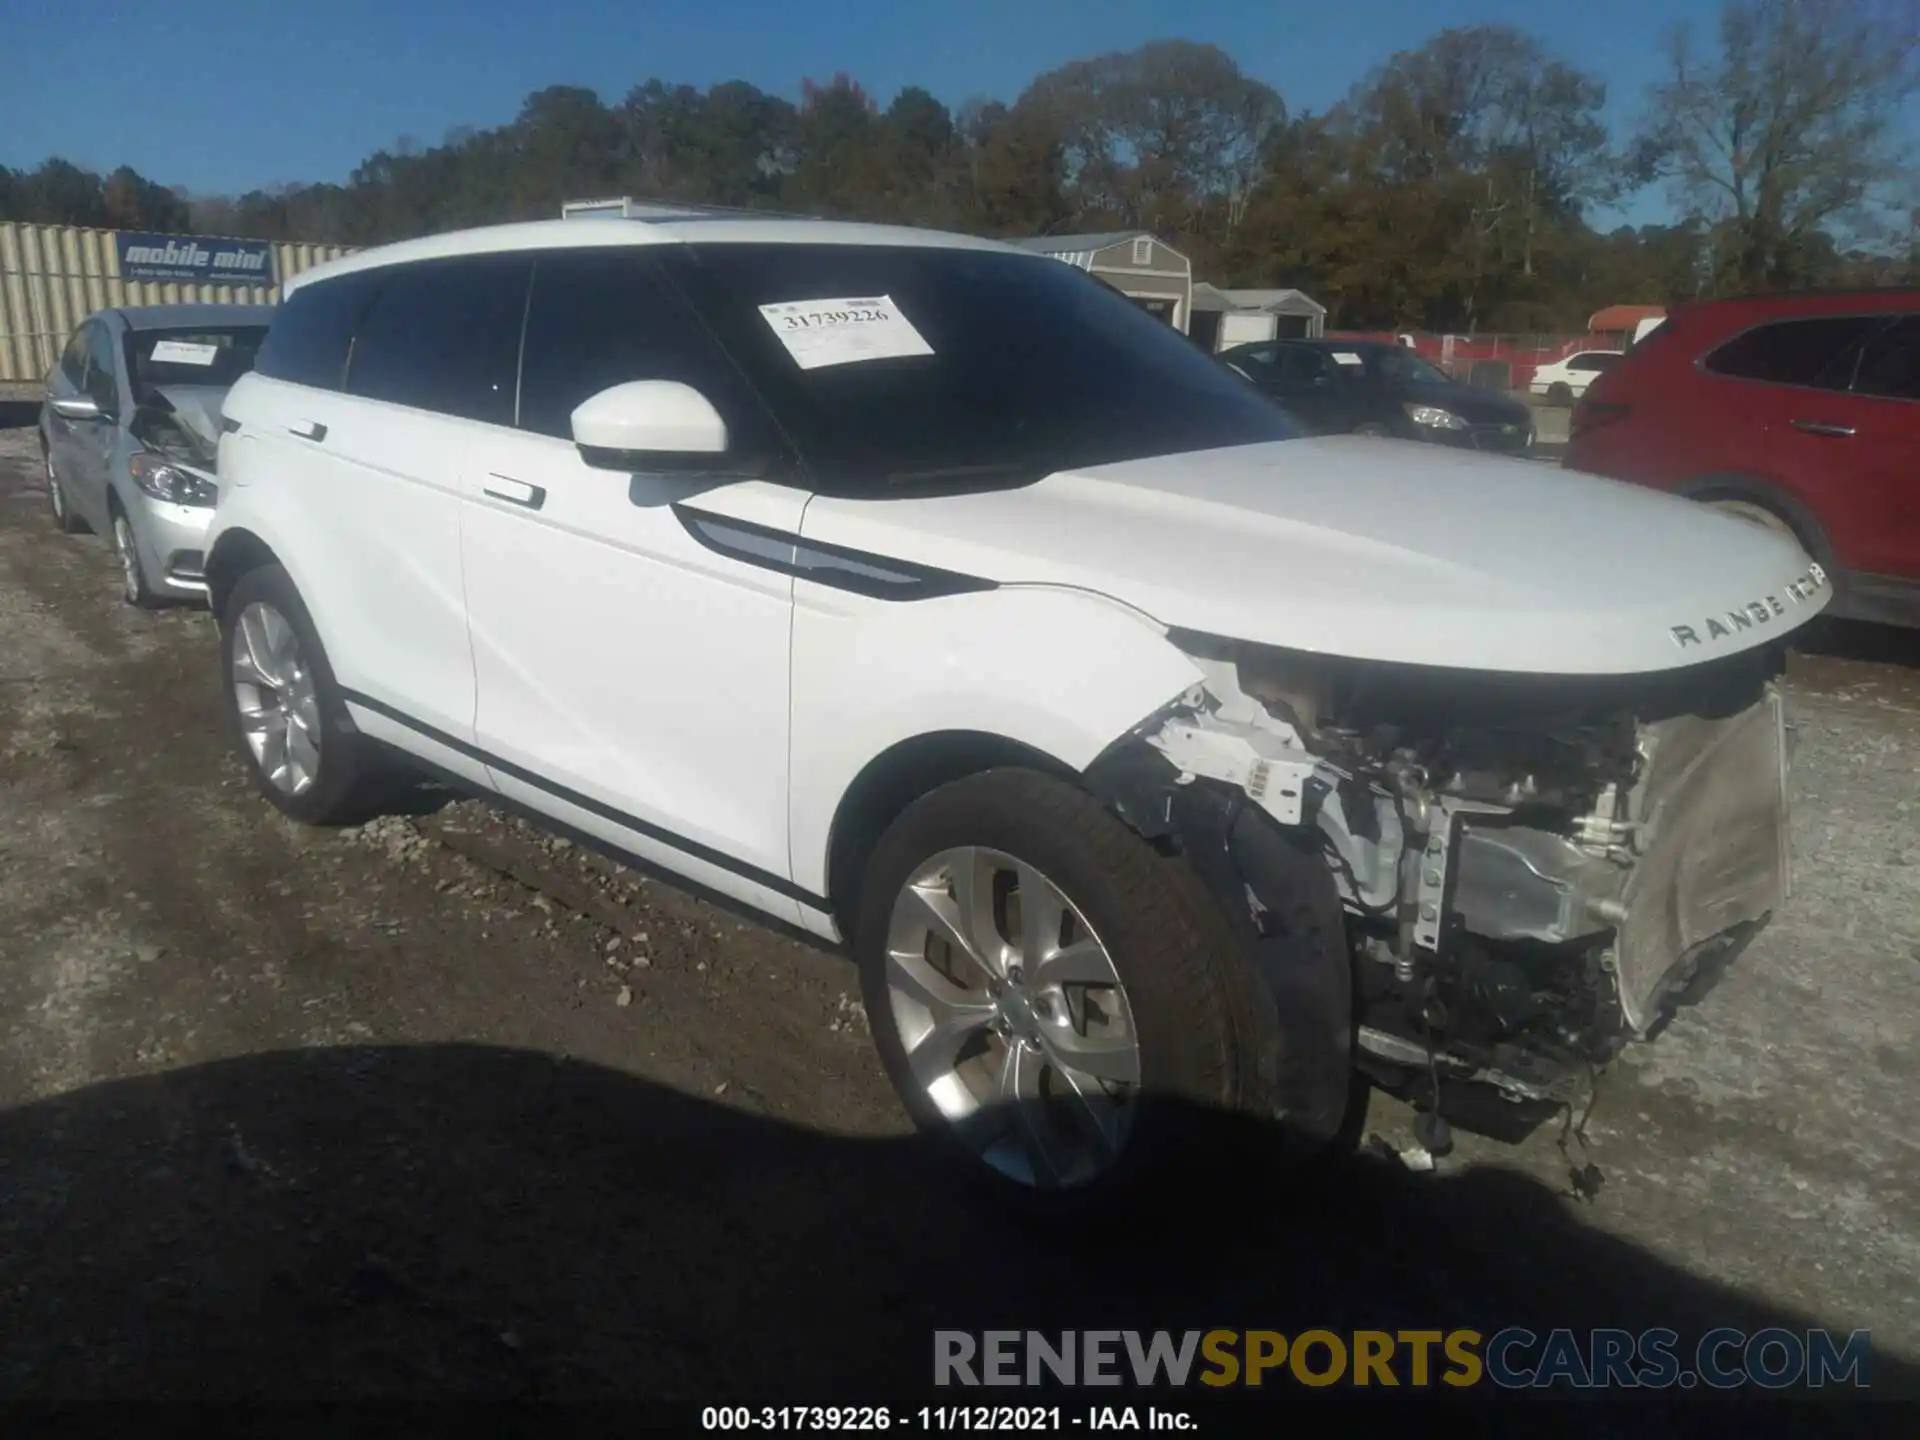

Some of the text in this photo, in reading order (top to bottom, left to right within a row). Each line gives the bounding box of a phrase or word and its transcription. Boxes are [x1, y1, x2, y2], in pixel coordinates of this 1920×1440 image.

[125, 240, 265, 270] mobile mini
[783, 308, 889, 330] 31739226
[1669, 595, 1784, 648] RANGE
